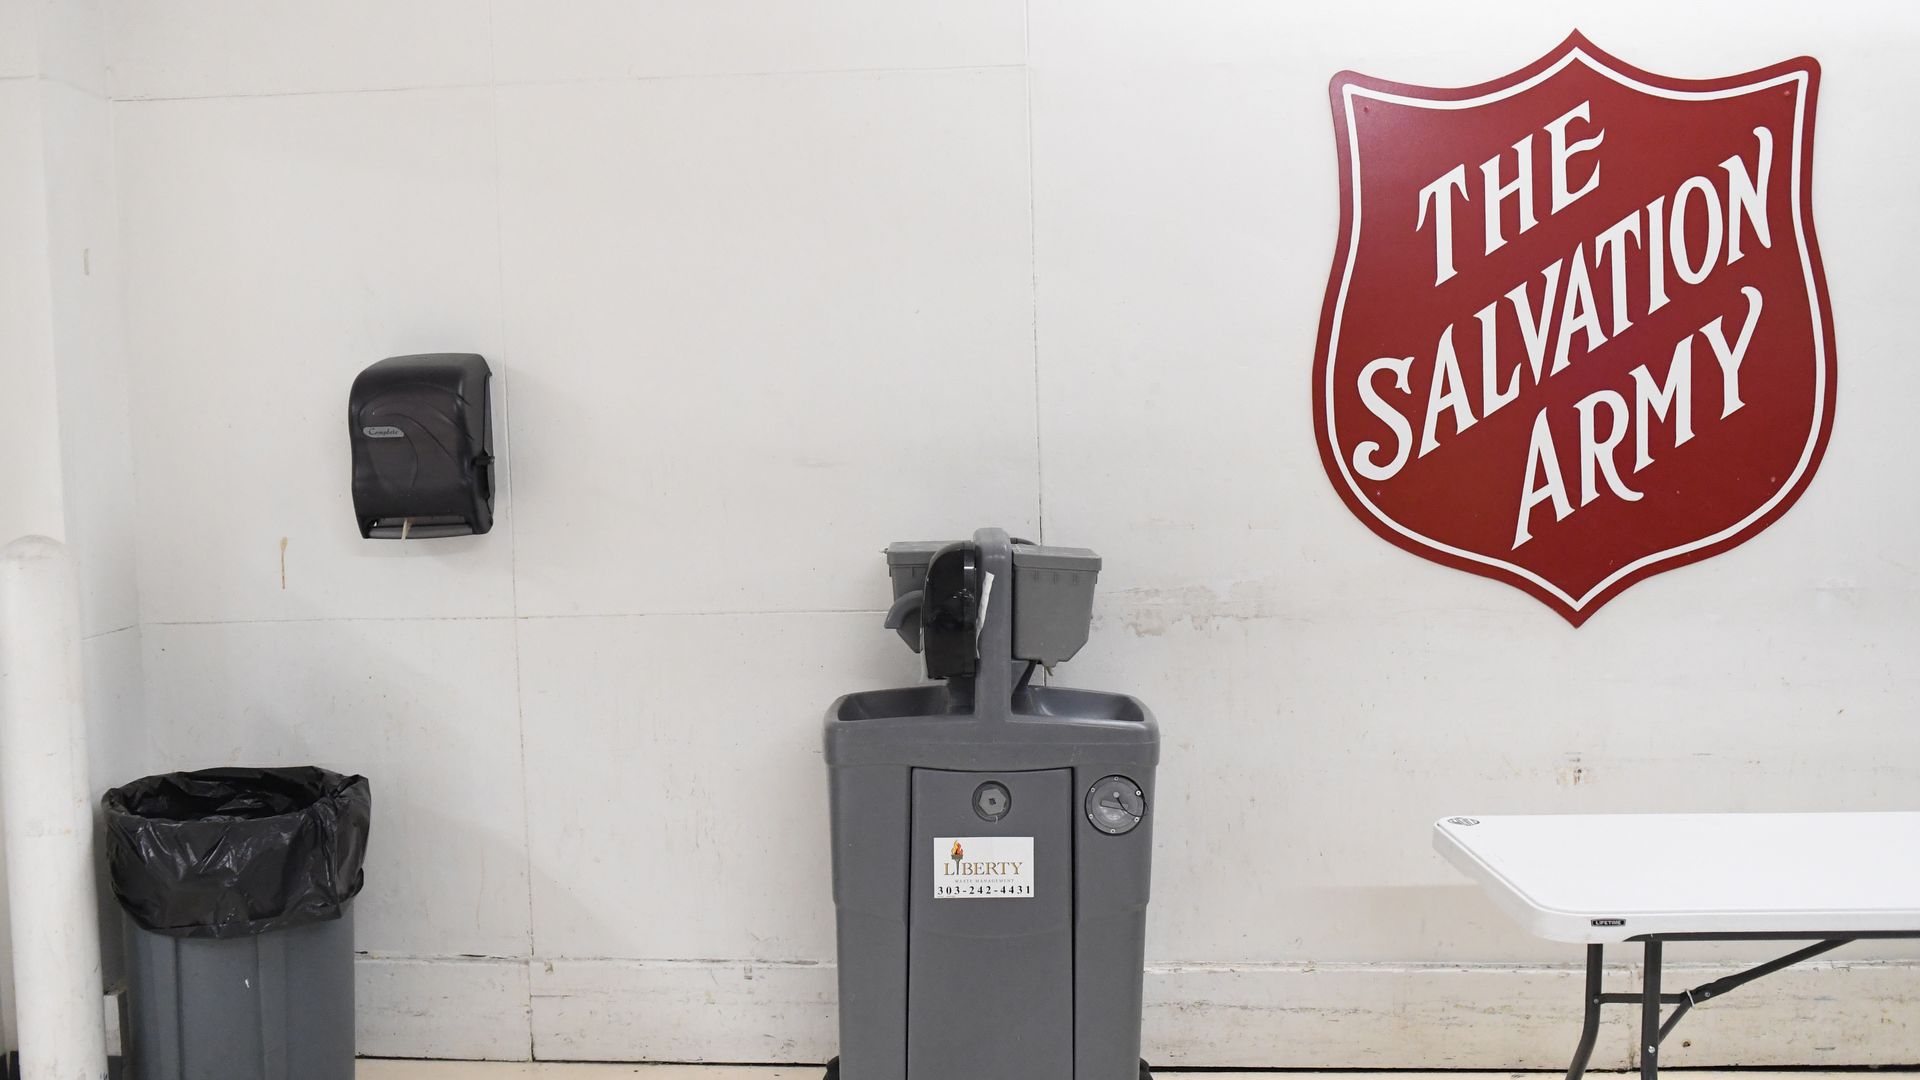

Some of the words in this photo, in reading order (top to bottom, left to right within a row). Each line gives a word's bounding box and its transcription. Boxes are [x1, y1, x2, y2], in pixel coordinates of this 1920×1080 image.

[1416, 100, 1605, 287] THE
[1352, 126, 1773, 481] SALVATION
[368, 428, 399, 436] Complete
[1511, 286, 1763, 551] ARMY
[937, 885, 1030, 895] 303-242-4431
[943, 861, 1023, 876] LIBERTY
